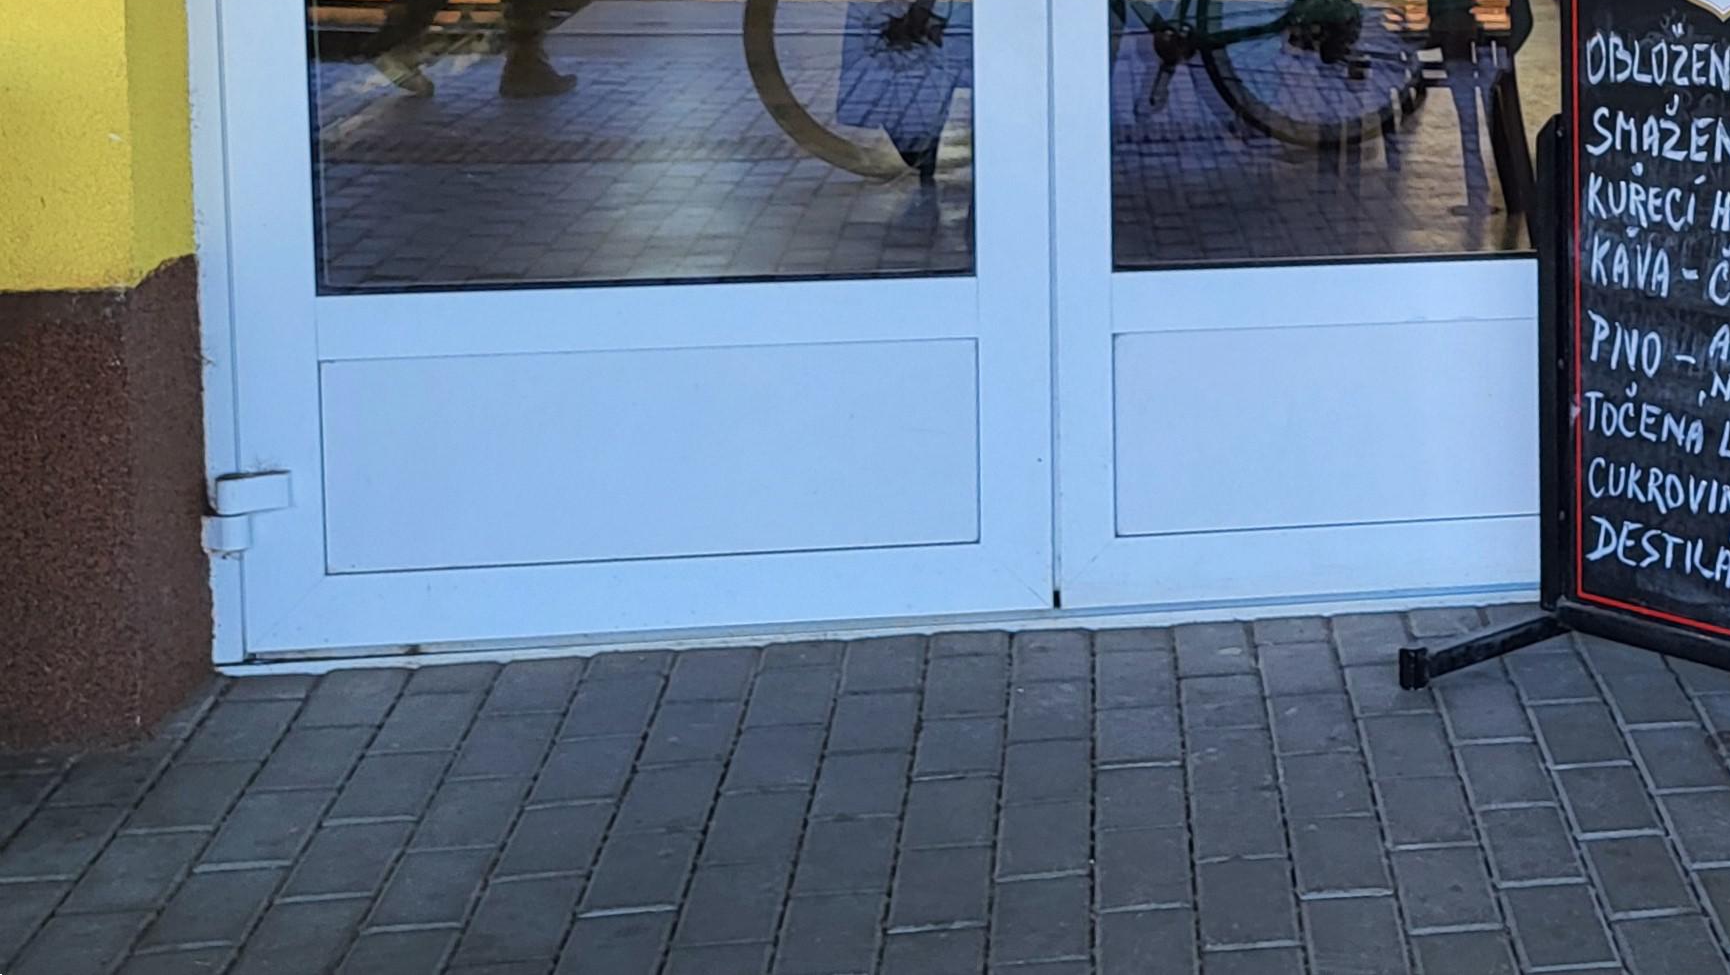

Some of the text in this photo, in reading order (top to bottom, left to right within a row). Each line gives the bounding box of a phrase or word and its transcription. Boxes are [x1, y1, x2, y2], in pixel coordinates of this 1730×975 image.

[1587, 162, 1707, 232] KUŘECÍ
[1681, 267, 1698, 280] -
[1587, 309, 1662, 377] PIVO
[1675, 354, 1696, 364] -
